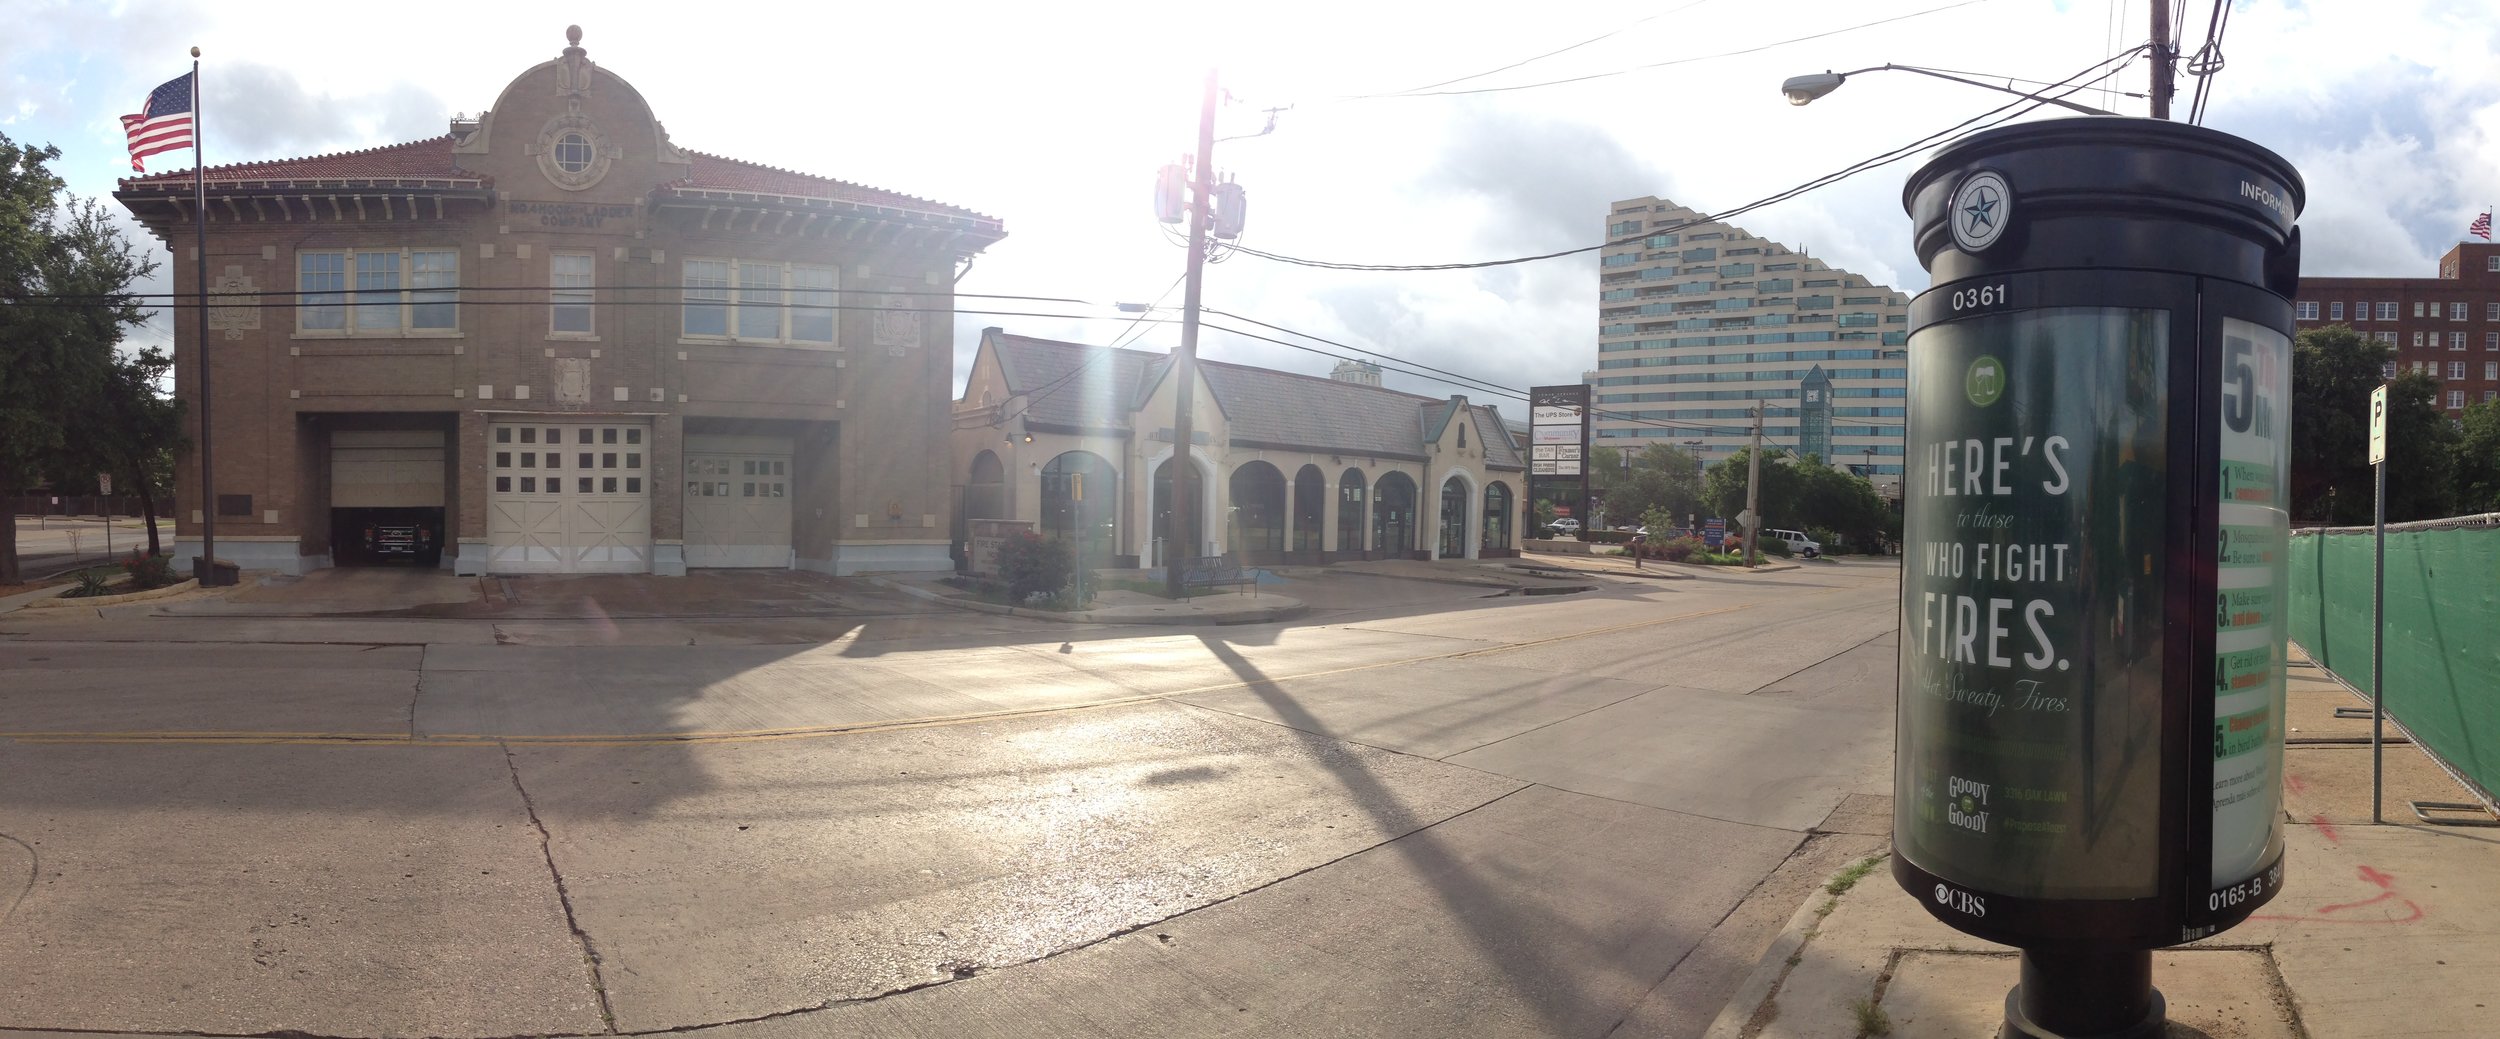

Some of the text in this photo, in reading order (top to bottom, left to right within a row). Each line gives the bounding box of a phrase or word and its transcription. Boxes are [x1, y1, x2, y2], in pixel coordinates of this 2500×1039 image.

[584, 205, 633, 218] LADDER
[2240, 180, 2291, 220] INFORMAT
[541, 215, 603, 228] COMPANY
[1953, 284, 2006, 311] 0361
[2223, 335, 2254, 434] 5
[2374, 400, 2383, 428] P
[1927, 435, 2070, 497] HERE'S
[2234, 466, 2255, 482] When
[2222, 465, 2232, 500] 1.
[1956, 502, 2014, 529] to those
[2219, 528, 2231, 563] 2.
[1926, 541, 2069, 582] WHO FIGHT
[2218, 593, 2230, 628] 3.
[2231, 591, 2250, 607] Make
[1923, 592, 2070, 671] FIRES.
[2216, 657, 2228, 691] 4.
[2231, 656, 2244, 670] Get
[1945, 671, 2006, 718] Sweaty.
[2014, 678, 2071, 713] Fires.
[2215, 724, 2228, 758] 5.
[1948, 775, 1991, 806] GOODY
[2213, 777, 2228, 791] earn
[1948, 802, 1989, 833] GOODY
[1948, 888, 1986, 918] CBS
